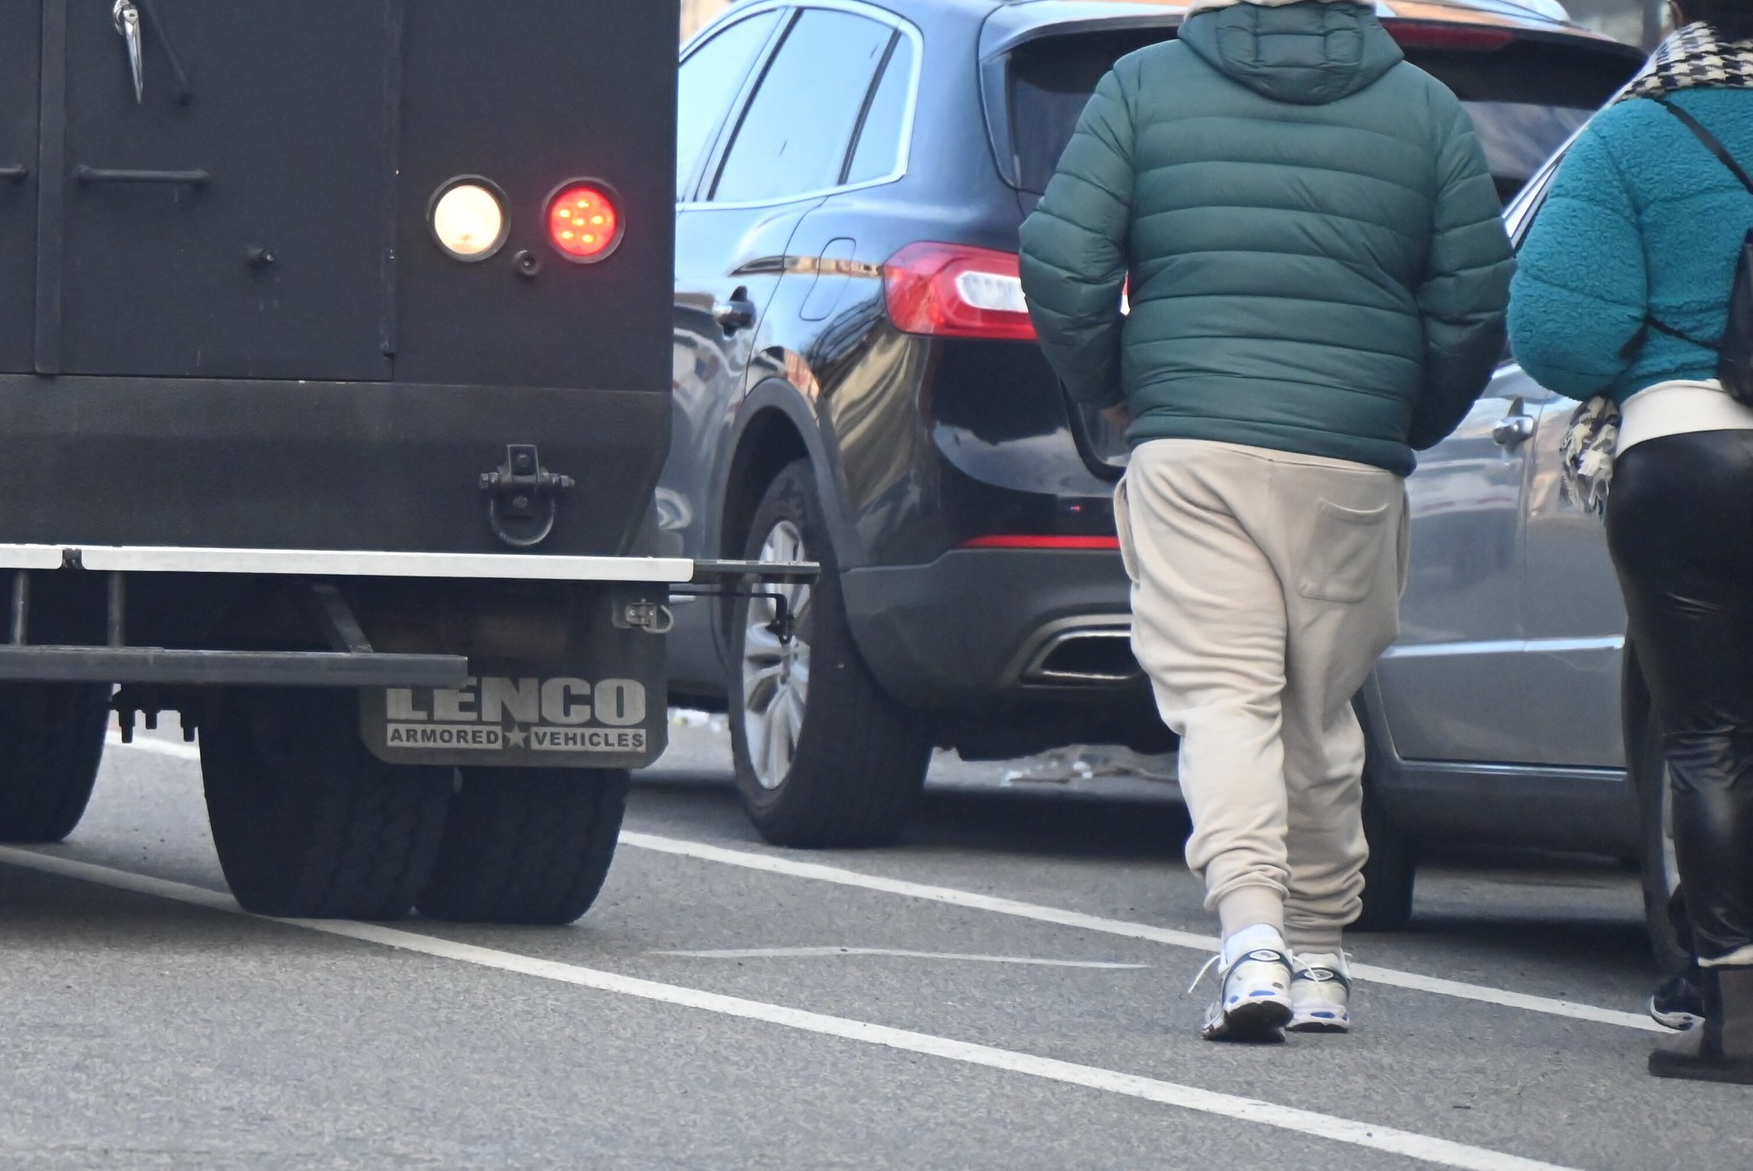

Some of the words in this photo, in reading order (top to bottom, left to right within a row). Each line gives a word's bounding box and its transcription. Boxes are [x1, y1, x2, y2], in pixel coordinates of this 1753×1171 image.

[386, 677, 646, 726] LENCO
[389, 728, 500, 745] ARMORED
[533, 731, 645, 748] VEHICLES
